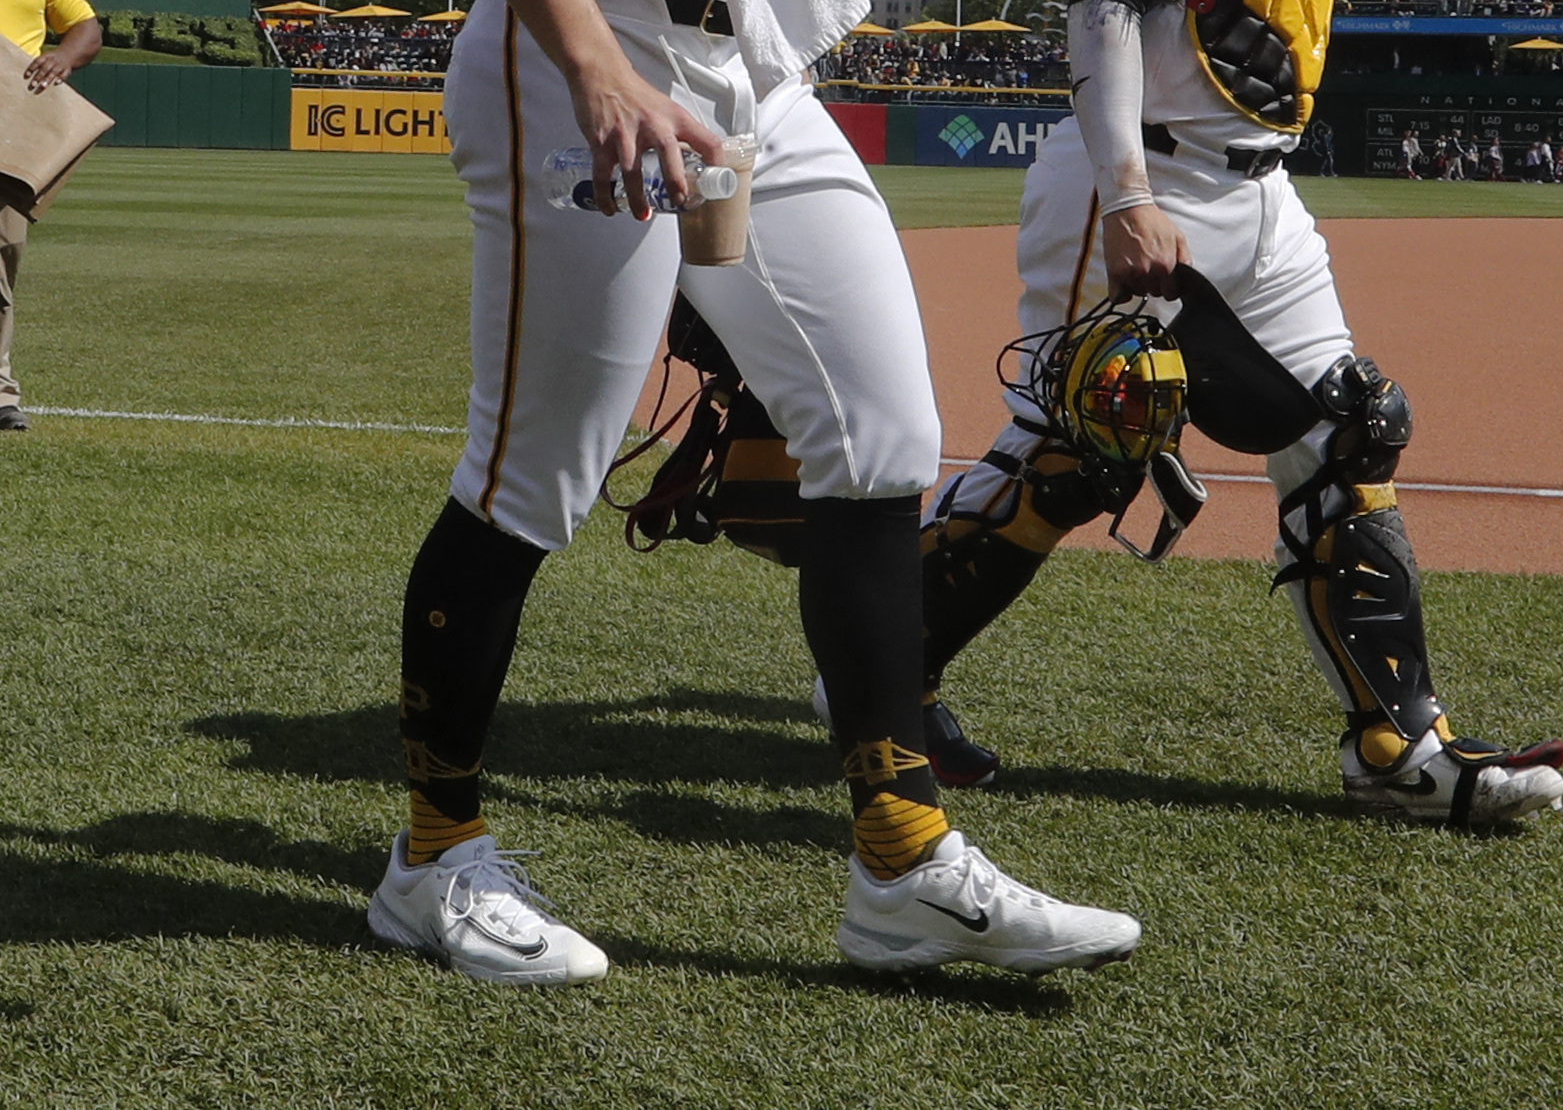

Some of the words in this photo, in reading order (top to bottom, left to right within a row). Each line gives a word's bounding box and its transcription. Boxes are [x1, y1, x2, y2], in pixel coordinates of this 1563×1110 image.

[1377, 113, 1394, 123] STL
[1481, 116, 1502, 125] LAD
[989, 121, 1056, 155] AH
[1483, 129, 1500, 138] SD
[1376, 148, 1394, 158] ATL
